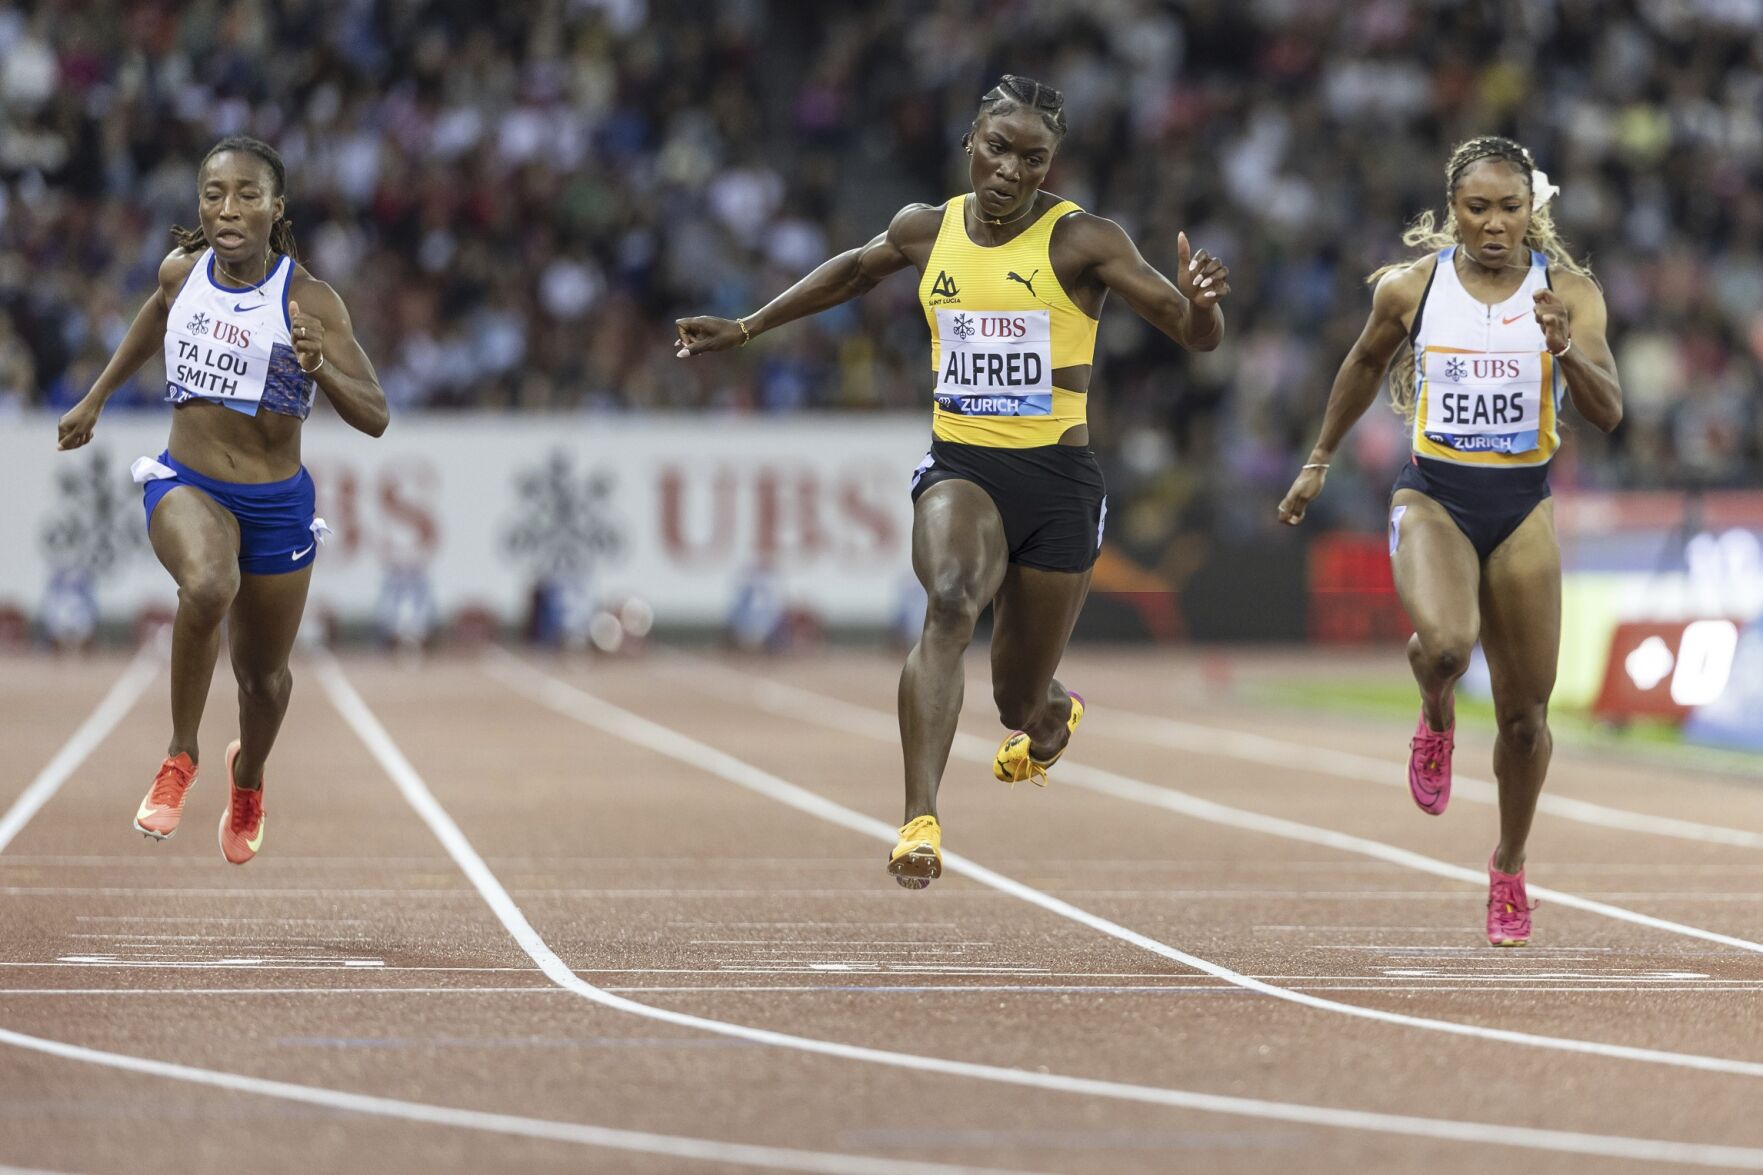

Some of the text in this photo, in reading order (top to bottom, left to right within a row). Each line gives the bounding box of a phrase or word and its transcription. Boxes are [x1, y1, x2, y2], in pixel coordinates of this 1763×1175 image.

[212, 320, 252, 349] UBS
[980, 317, 1026, 338] UBS
[178, 340, 248, 376] TA LOU
[943, 350, 1042, 387] ALFRED
[1472, 359, 1520, 379] UBS
[176, 364, 238, 396] SMITH
[960, 397, 1019, 413] ZURICH
[1442, 391, 1524, 425] SEARS
[1454, 436, 1512, 450] ZURICH
[656, 461, 901, 570] UBS
